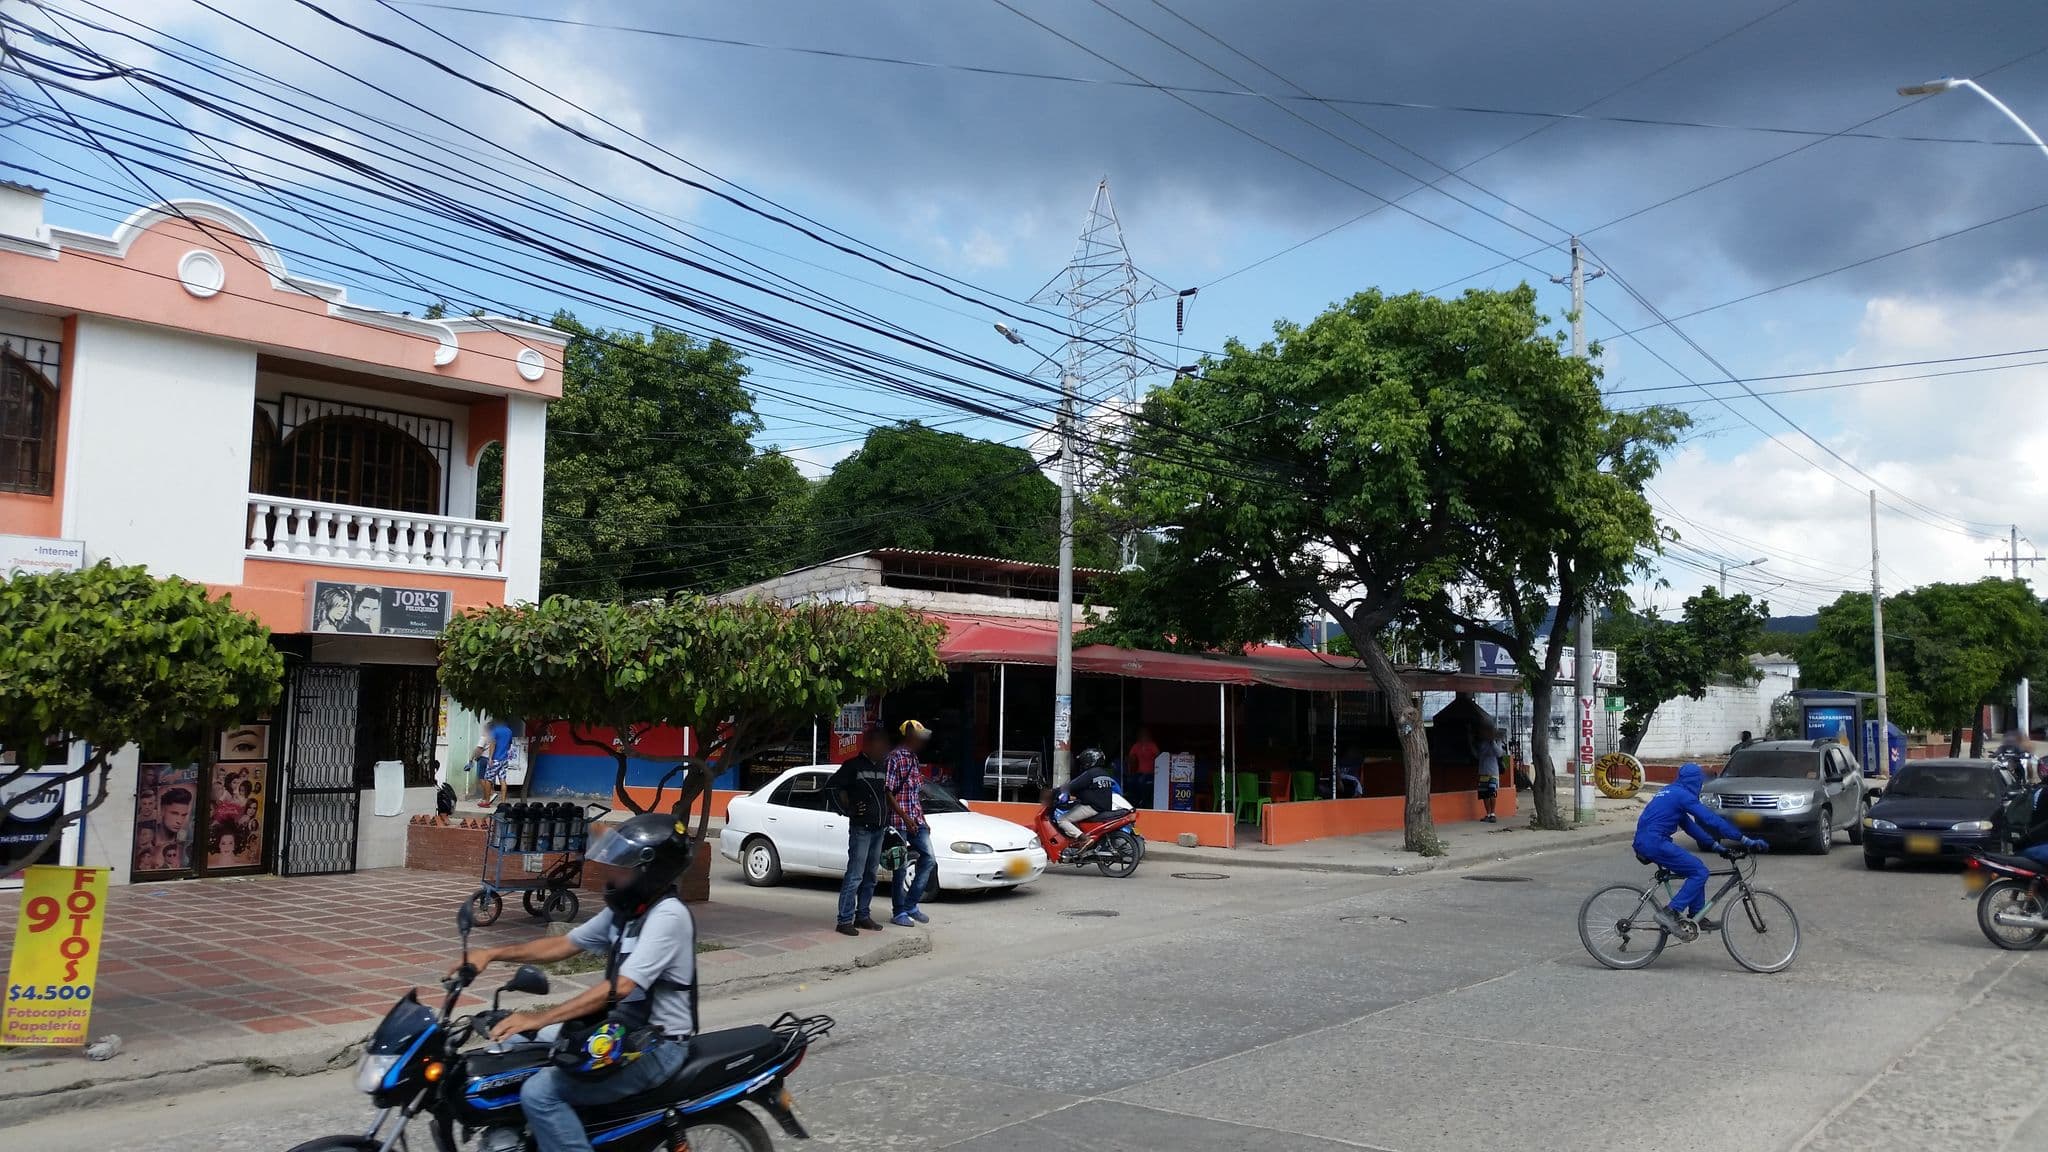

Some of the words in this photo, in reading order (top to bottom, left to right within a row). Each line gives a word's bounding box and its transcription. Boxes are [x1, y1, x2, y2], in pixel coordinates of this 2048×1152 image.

[39, 547, 78, 557] Internet
[392, 590, 439, 608] JOR'S
[1581, 699, 1594, 764] VIDRIOS
[1175, 790, 1191, 798] 200
[26, 896, 60, 933] 9
[60, 869, 96, 982] FOTOS
[9, 984, 91, 1001] $4.500
[8, 1007, 87, 1019] Fotocopias
